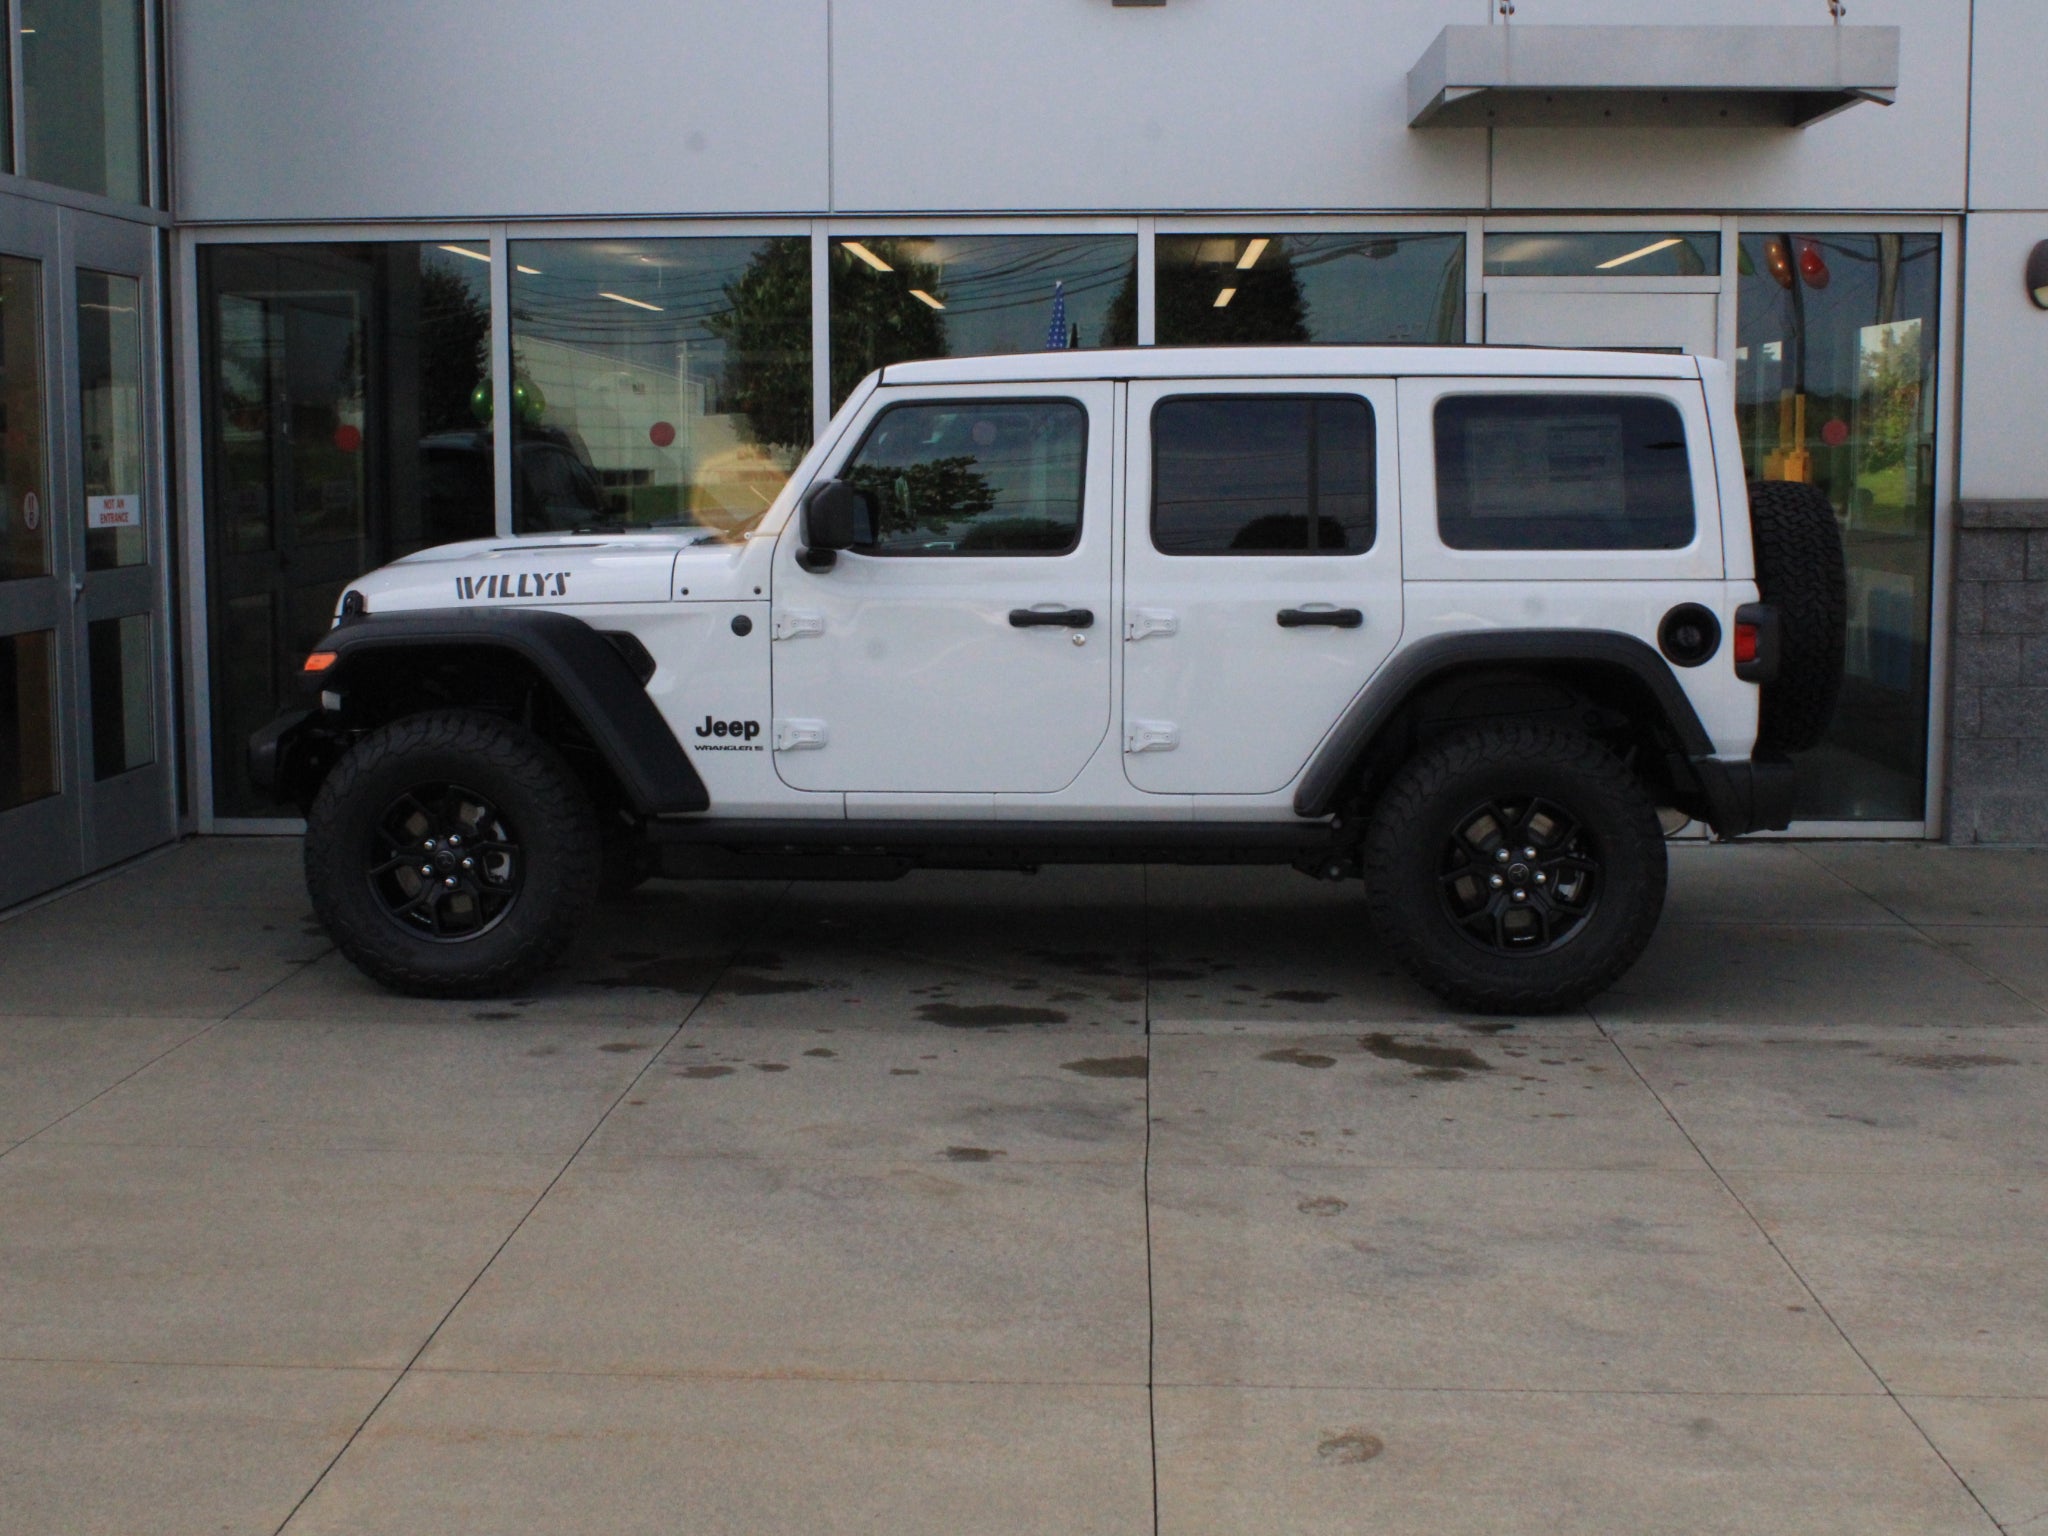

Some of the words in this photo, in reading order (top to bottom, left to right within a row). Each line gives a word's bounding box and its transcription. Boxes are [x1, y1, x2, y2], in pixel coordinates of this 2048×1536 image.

[100, 512, 129, 524] ENTRANCE
[455, 572, 571, 600] WILLYS
[695, 715, 760, 741] Jeep
[694, 744, 753, 752] WRANGLER
